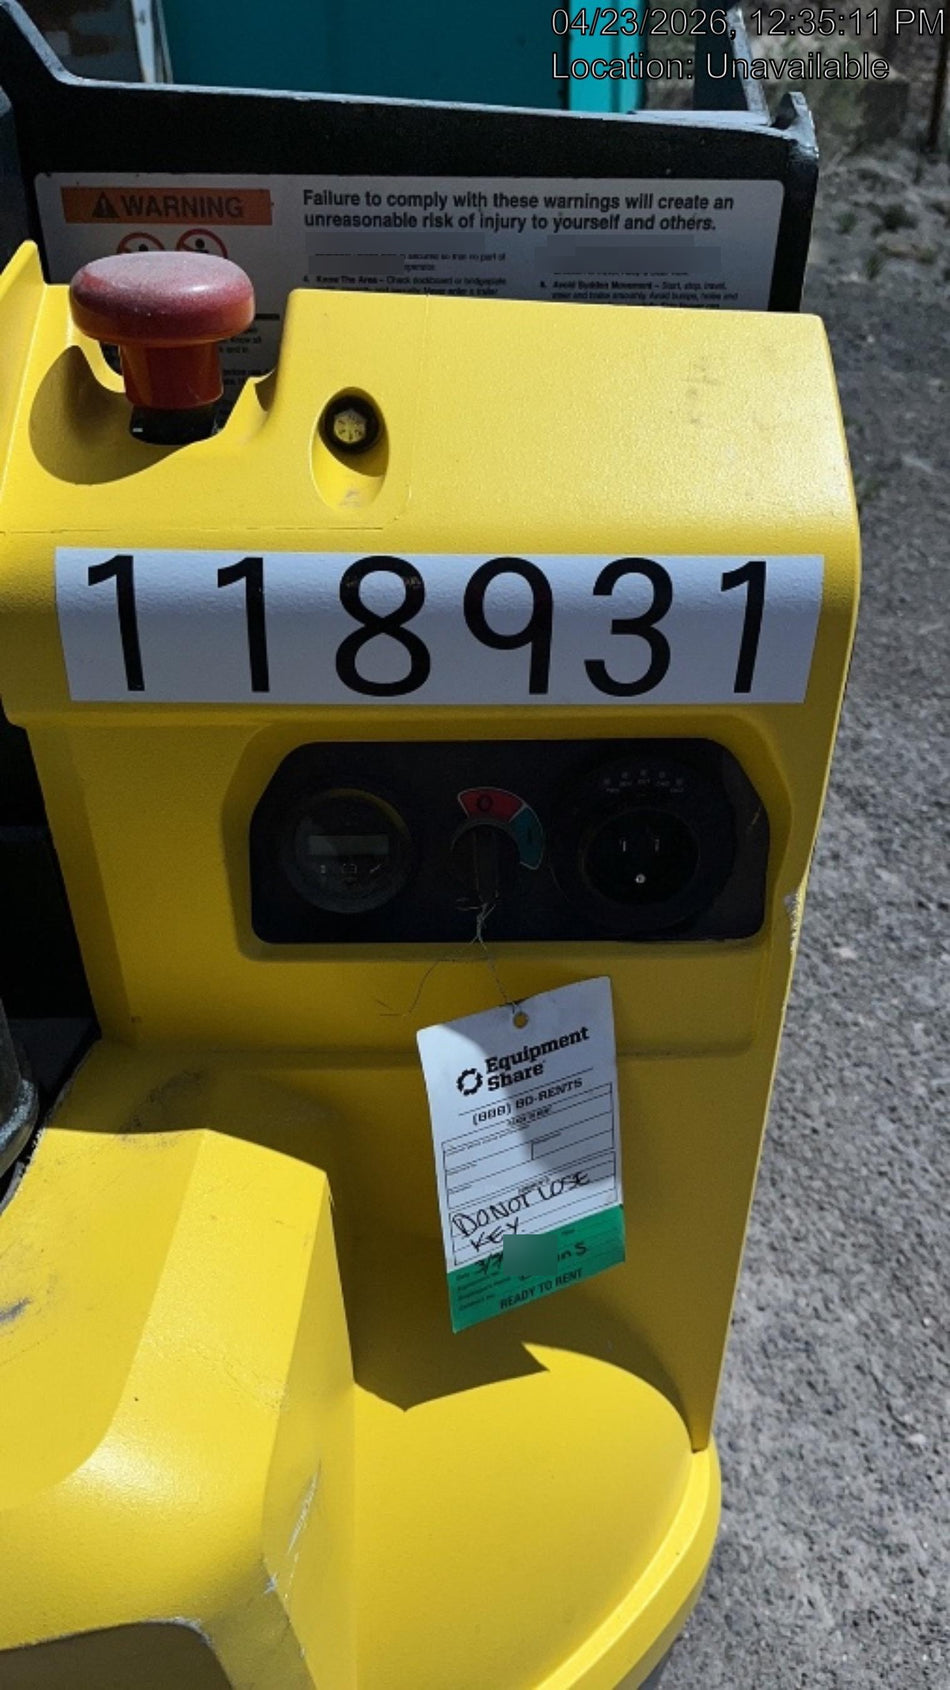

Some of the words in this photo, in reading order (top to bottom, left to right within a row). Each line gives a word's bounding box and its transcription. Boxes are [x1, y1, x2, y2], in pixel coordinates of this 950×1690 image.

[120, 194, 244, 219] WARNING
[303, 189, 361, 206] Failure
[365, 191, 382, 206] to
[387, 190, 448, 210] comply
[453, 191, 488, 208] with
[493, 192, 540, 208] these
[543, 193, 620, 213] warnings
[625, 193, 654, 209] will
[658, 194, 709, 210] create
[714, 197, 734, 210] an
[304, 212, 418, 228] unreasonable
[422, 212, 454, 228] risk
[458, 212, 476, 228] of
[480, 213, 526, 233] injury
[531, 214, 549, 230] to
[552, 214, 620, 233] yourself
[625, 215, 655, 230] and
[659, 215, 717, 231] others.
[87, 554, 768, 698] 118931
[485, 1026, 590, 1075] Equipment
[487, 1062, 545, 1092] Share
[470, 1216, 520, 1252] KEY
[500, 1286, 535, 1310] READY
[538, 1279, 553, 1295] TO
[555, 1268, 583, 1287] RENT
